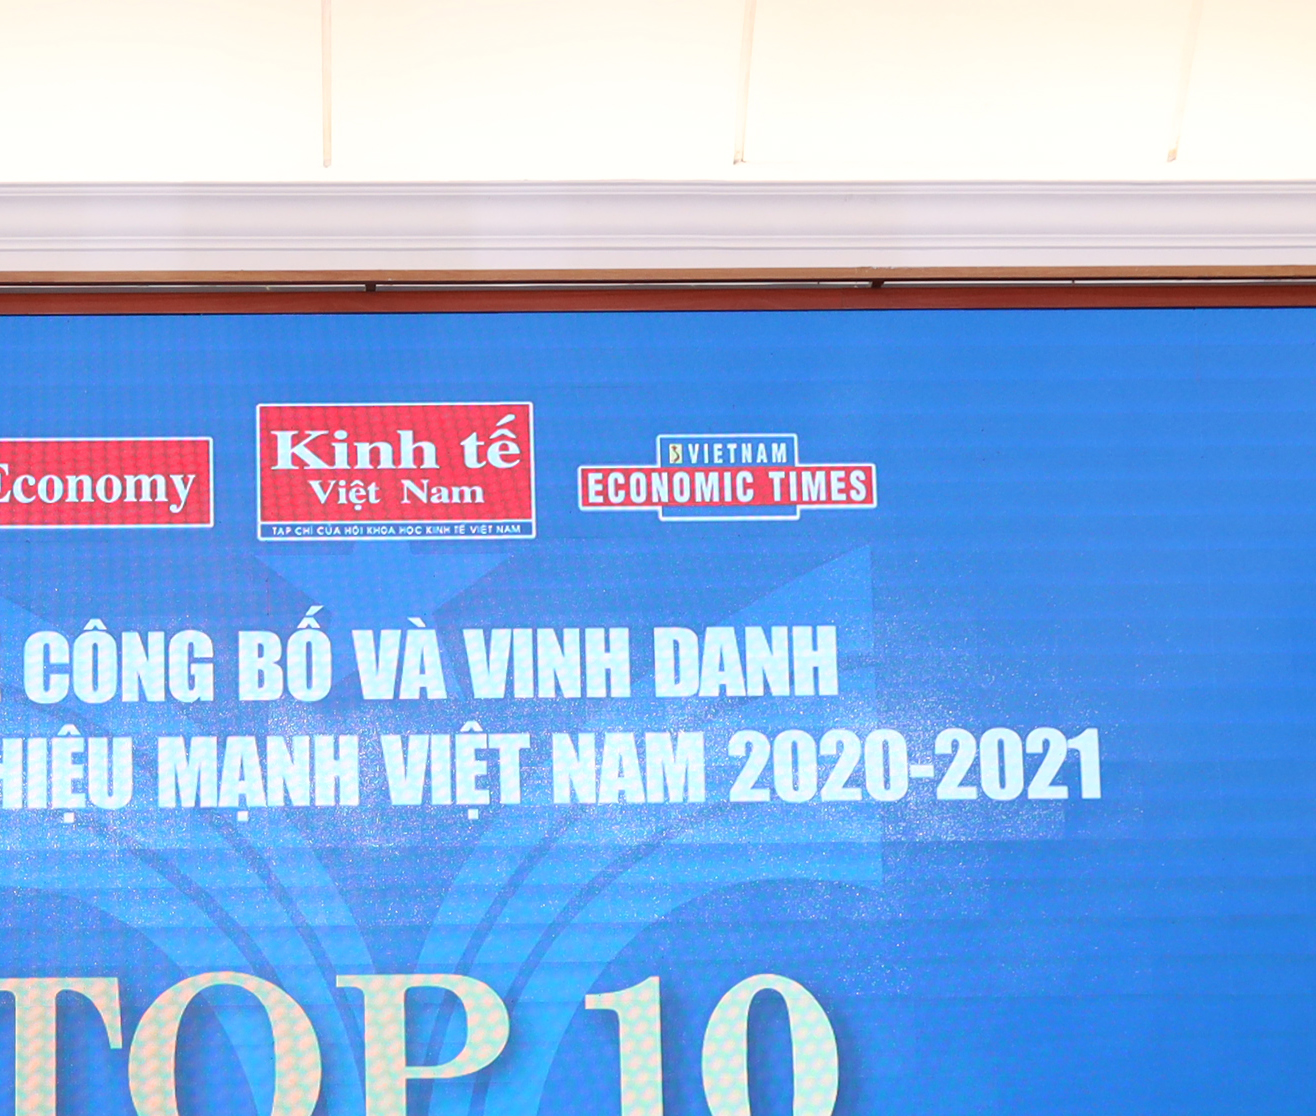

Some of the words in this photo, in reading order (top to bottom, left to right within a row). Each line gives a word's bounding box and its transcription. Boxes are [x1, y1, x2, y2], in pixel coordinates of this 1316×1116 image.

[271, 429, 440, 469] Kinh
[460, 414, 521, 469] tế
[687, 443, 787, 463] VIETNAM
[308, 479, 381, 511] Việt
[401, 479, 485, 504] Nam
[587, 471, 754, 503] ECONOMIC
[768, 470, 867, 502] TIMES
[367, 525, 396, 536] KHOA
[426, 525, 450, 535] KINH
[496, 524, 521, 534] NAM
[23, 617, 215, 704] CÔNG
[238, 606, 333, 703] BỐ
[352, 617, 446, 701] VÀ
[462, 626, 631, 700] VINH
[653, 625, 839, 698] DANH
[157, 733, 360, 823] MẠNH
[381, 720, 530, 820] VIỆT
[552, 731, 706, 805] NAM
[727, 726, 1102, 803] 2020-2021
